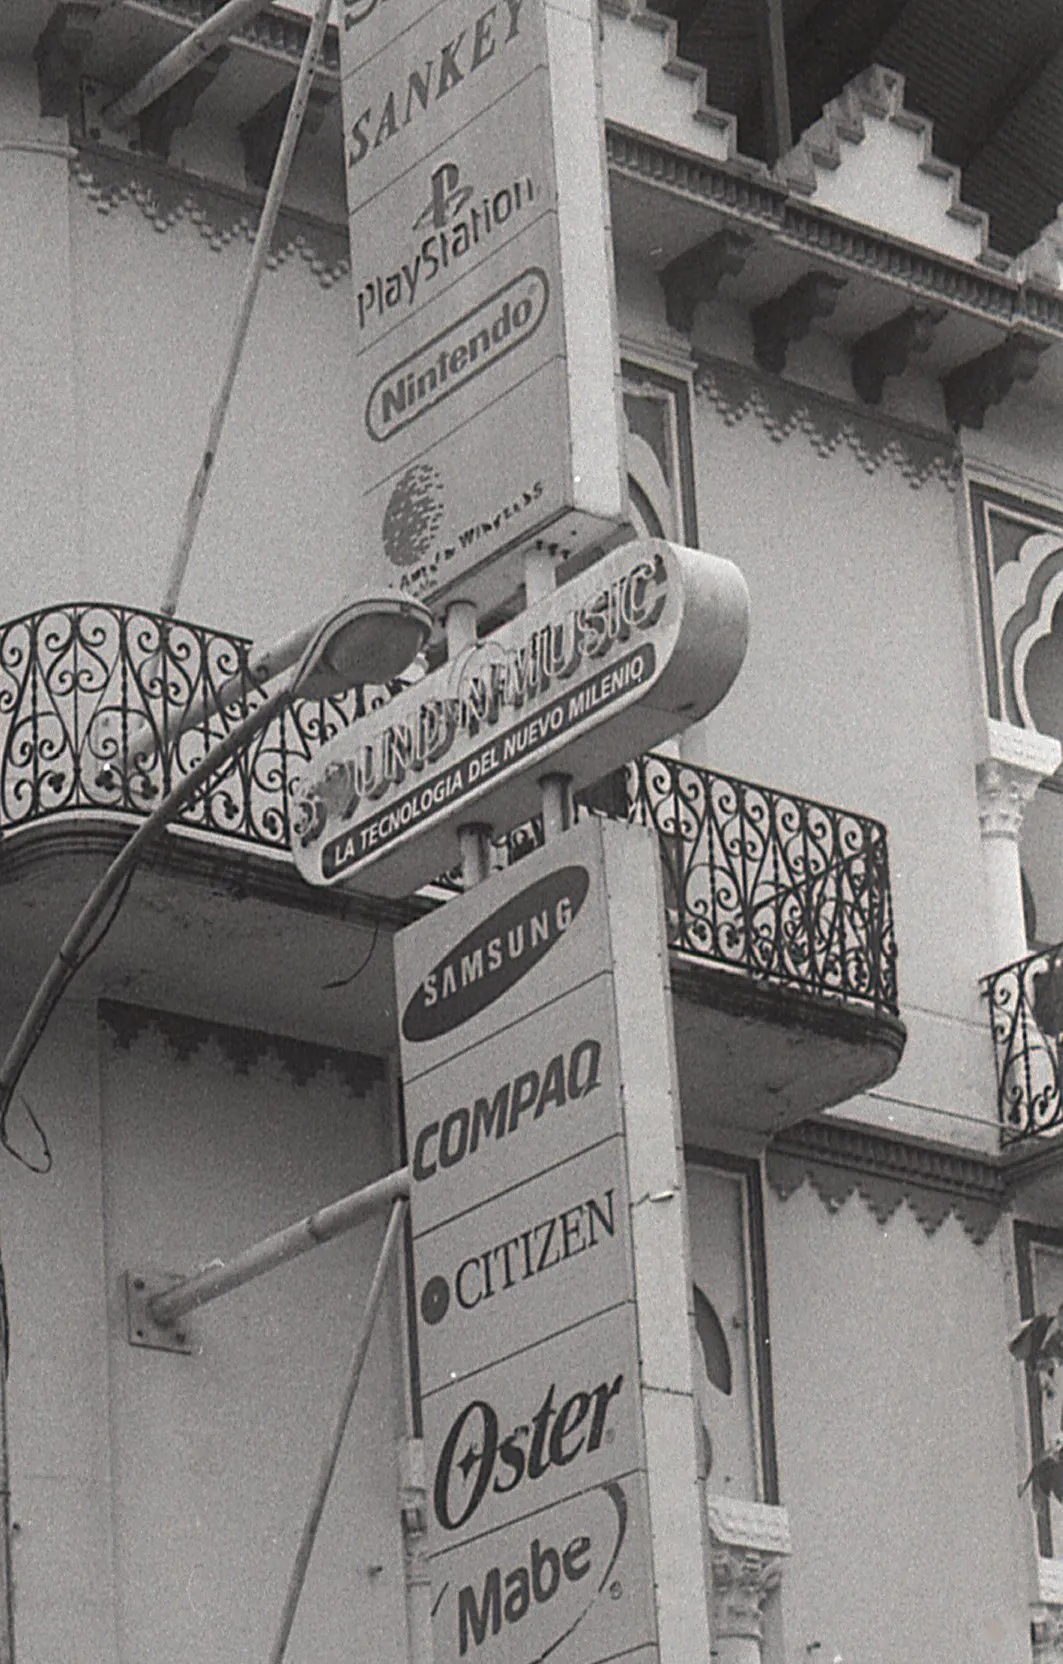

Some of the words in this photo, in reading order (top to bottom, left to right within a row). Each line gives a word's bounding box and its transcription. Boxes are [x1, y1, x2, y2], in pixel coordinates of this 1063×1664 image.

[348, 0, 523, 168] SANKEY
[357, 177, 533, 328] PlayStation
[381, 297, 535, 425] Nintendo
[335, 838, 356, 866] LA
[361, 777, 463, 849] TECNOLOGIA
[468, 754, 500, 785] DEL
[503, 713, 563, 762] NUEVO
[569, 655, 644, 719] MILENIO
[424, 897, 574, 1006] SAMSUNG
[413, 1039, 602, 1183] COMPAQ
[455, 1190, 615, 1310] CITIZEN
[435, 1374, 624, 1530] Oster
[457, 1536, 592, 1657] Mabe
